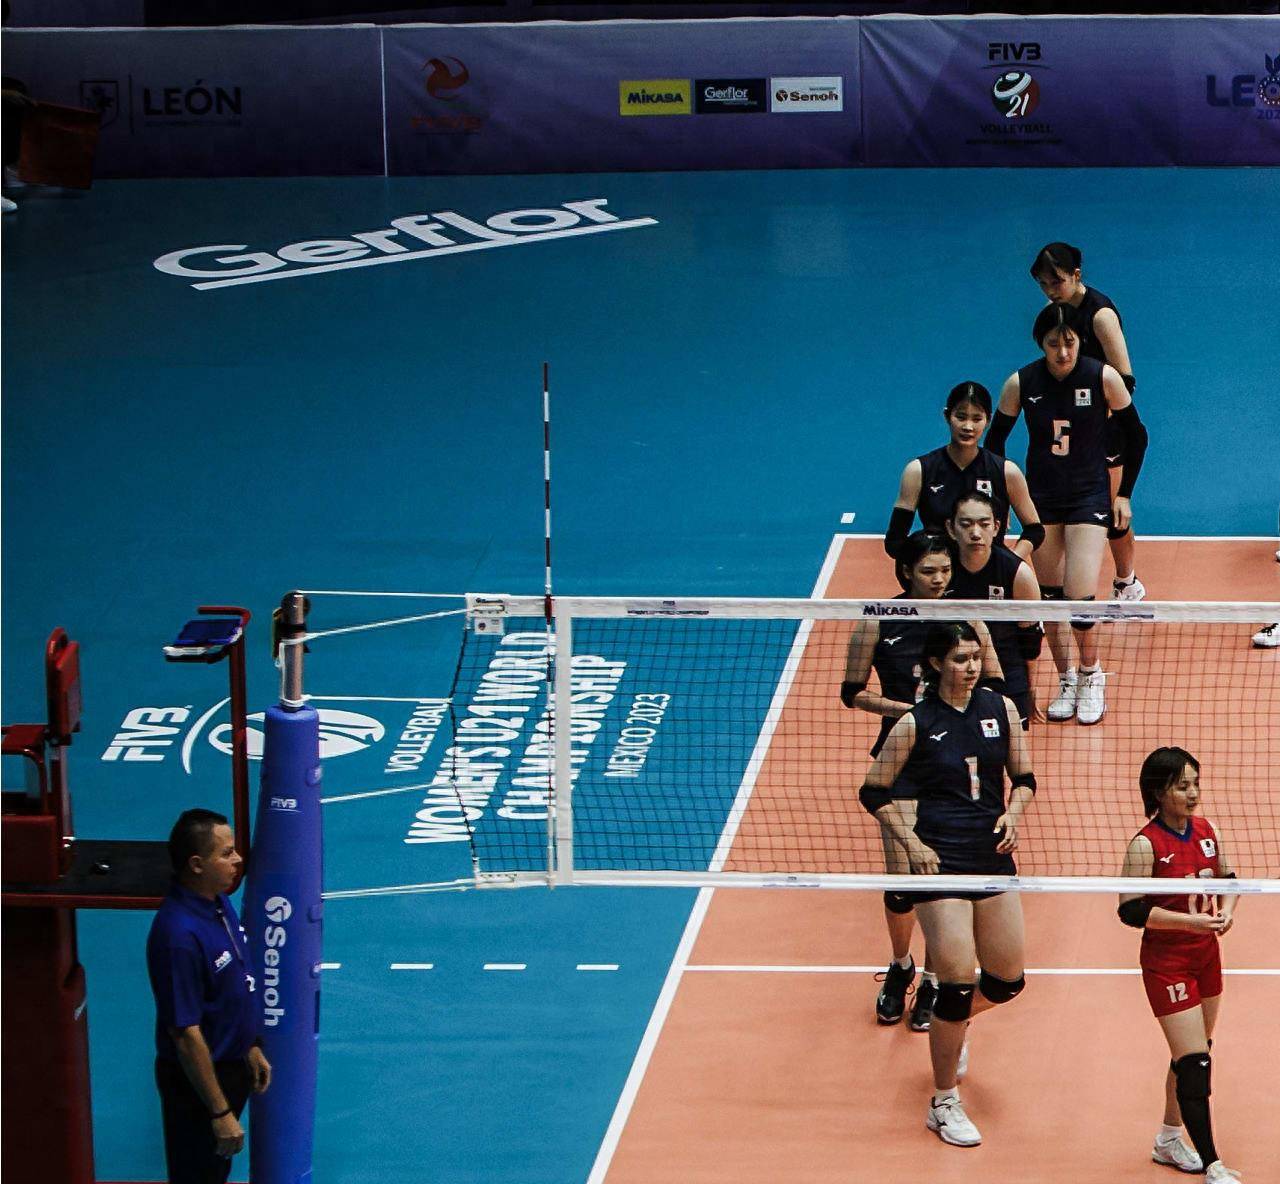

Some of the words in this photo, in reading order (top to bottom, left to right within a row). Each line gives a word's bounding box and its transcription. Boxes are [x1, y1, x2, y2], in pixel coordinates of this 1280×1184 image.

[989, 43, 1041, 60] FIVB
[144, 79, 242, 116] LEÓN
[704, 86, 749, 100] Gerflor
[790, 91, 838, 101] Senoh
[153, 198, 608, 279] Gerflor
[1051, 419, 1071, 456] 5
[473, 631, 556, 702] WORLD
[454, 704, 530, 743] U21
[625, 693, 671, 726] 2023
[100, 706, 190, 762] FIVB
[384, 700, 450, 774] VOLLEYBALL
[603, 727, 656, 778] MEXICO
[403, 746, 512, 844] WOMEN'S
[963, 756, 980, 800] 1
[264, 924, 286, 1028] Senoh
[1166, 983, 1189, 1005] 12
